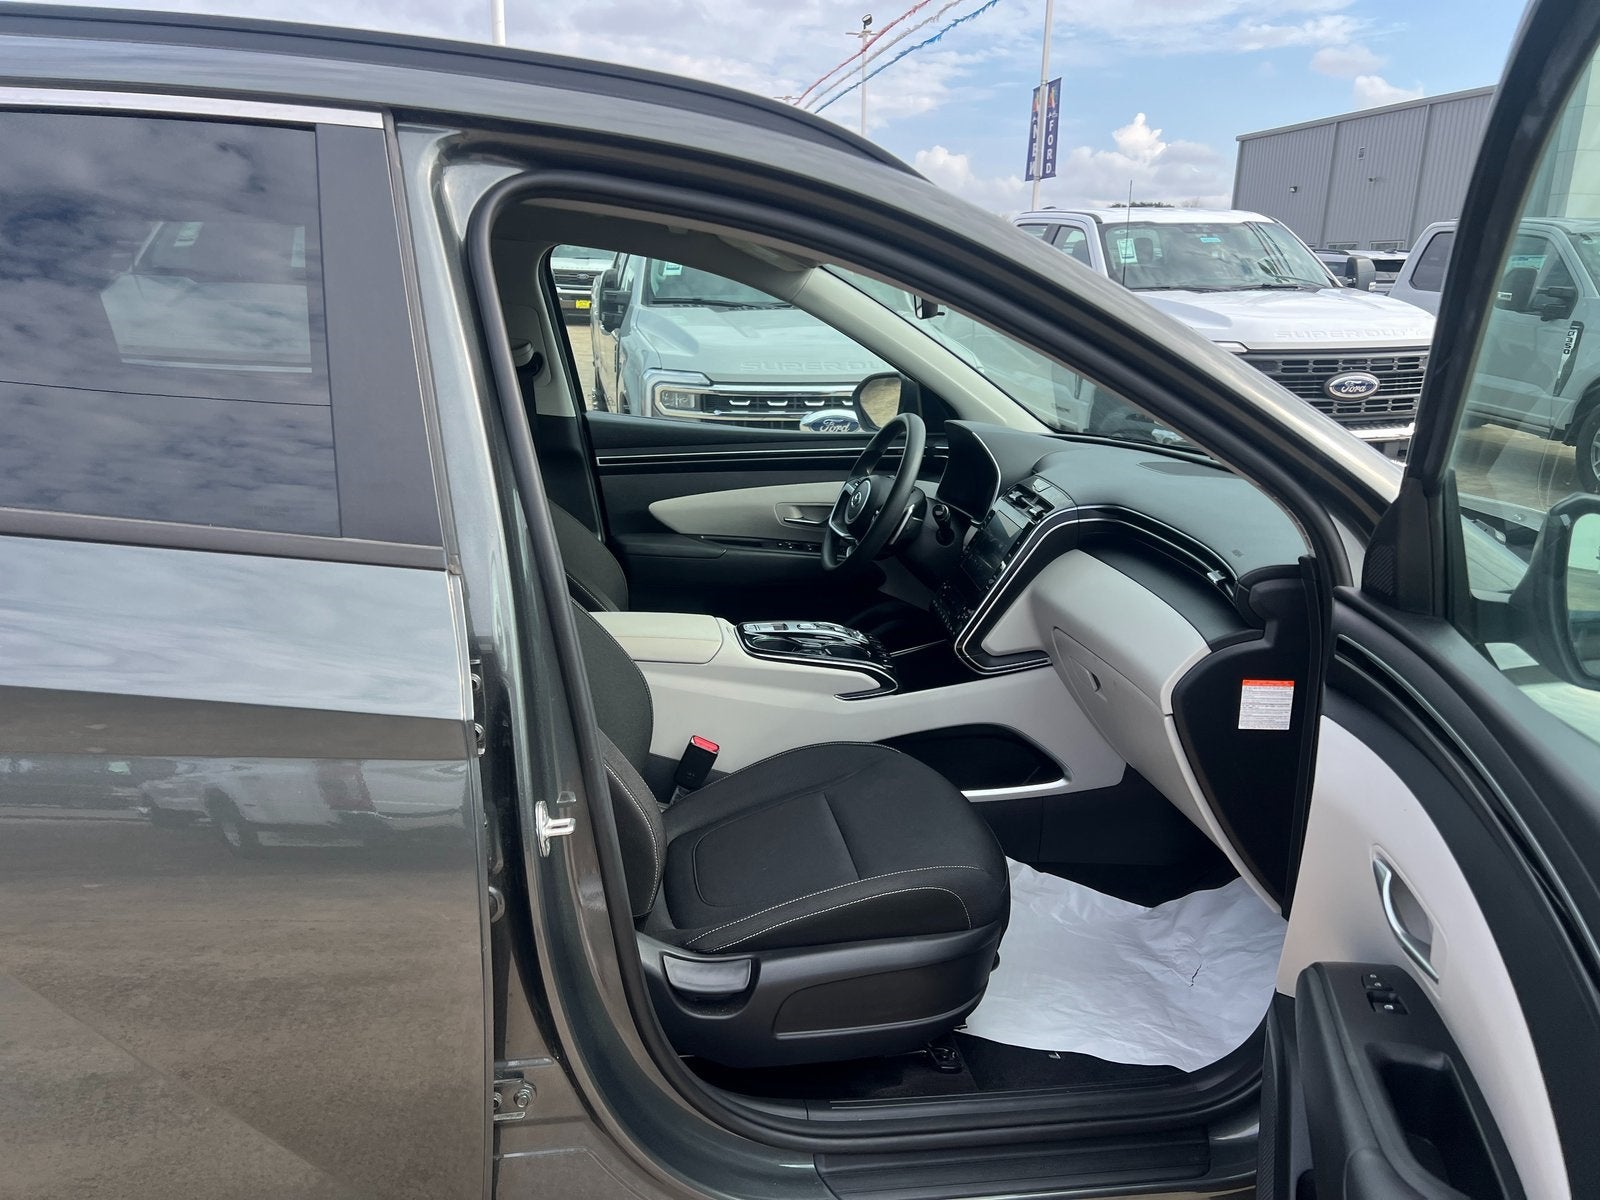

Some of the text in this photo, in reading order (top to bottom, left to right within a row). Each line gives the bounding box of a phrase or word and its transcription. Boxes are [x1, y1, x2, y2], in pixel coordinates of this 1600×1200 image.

[1045, 120, 1054, 174] FORD
[1275, 328, 1361, 339] SUPER
[739, 360, 881, 371] SUPER DU
[1340, 380, 1367, 393] Ford
[820, 418, 851, 432] Ford
